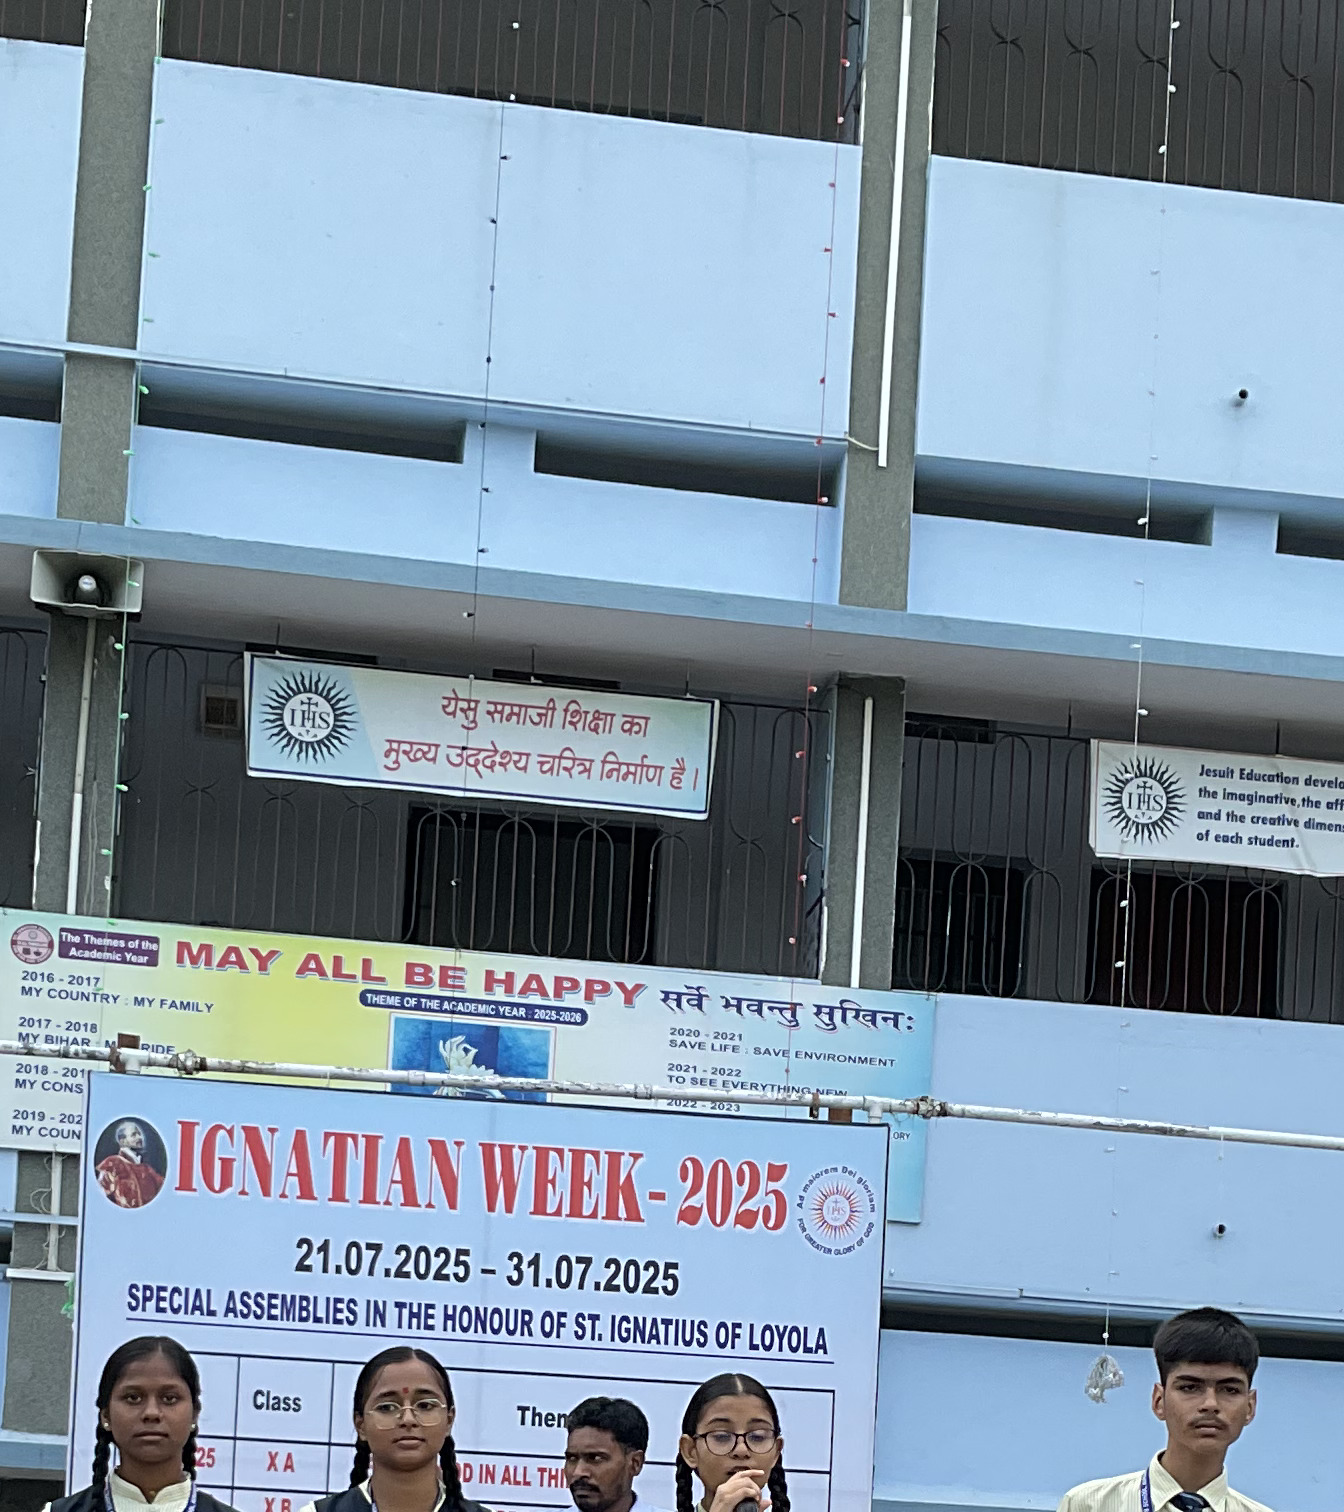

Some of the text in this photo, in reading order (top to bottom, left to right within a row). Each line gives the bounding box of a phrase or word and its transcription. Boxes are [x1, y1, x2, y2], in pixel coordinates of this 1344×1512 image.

[289, 707, 332, 730] IHS
[1199, 764, 1234, 781] Jesuit
[1239, 767, 1299, 785] Education
[1126, 790, 1164, 812] IHS
[1198, 786, 1217, 801] the
[1197, 810, 1221, 821] and
[1226, 811, 1246, 823] the
[1250, 814, 1300, 828] creative
[1196, 830, 1210, 842] of
[1214, 832, 1243, 845] each
[61, 932, 158, 951] The Themes of the
[69, 947, 149, 963] Academic Year
[22, 970, 100, 987] 2016 2017
[176, 941, 648, 1007] MAY ALL BE HAPPY
[21, 986, 215, 1014] MY COUNTRY MY FAMILY
[366, 993, 582, 1023] THEME OF THE ACADEMIC YEAR 2025-2026
[19, 1017, 98, 1034] 2017 2018
[669, 1027, 743, 1042] 2020 2021
[18, 1032, 91, 1047] MY BIHAR
[669, 1039, 896, 1068] SAVE LIFE SAVE ENVIRONMENT
[16, 1063, 48, 1076] 2018
[667, 1062, 742, 1078] 2021 2022
[14, 1078, 84, 1094] MY CONS
[667, 1075, 811, 1095] TO SEE EVERYTHING
[13, 1109, 46, 1121] 2019
[666, 1099, 741, 1112] 2022 2023
[11, 1124, 81, 1140] MY COUN
[174, 1119, 465, 1211] IGNATIAN
[677, 1156, 788, 1231] 2025
[294, 1237, 679, 1296] 21.07.2025 31.07.2025
[127, 1283, 828, 1355] SPECIAL ASSEMBLIES IN THE HONOUR OF ST. IGNATIUS OF LOYOLA
[253, 1389, 302, 1412] Class
[266, 1451, 295, 1472] X A
[479, 1464, 532, 1487] IN ALL
